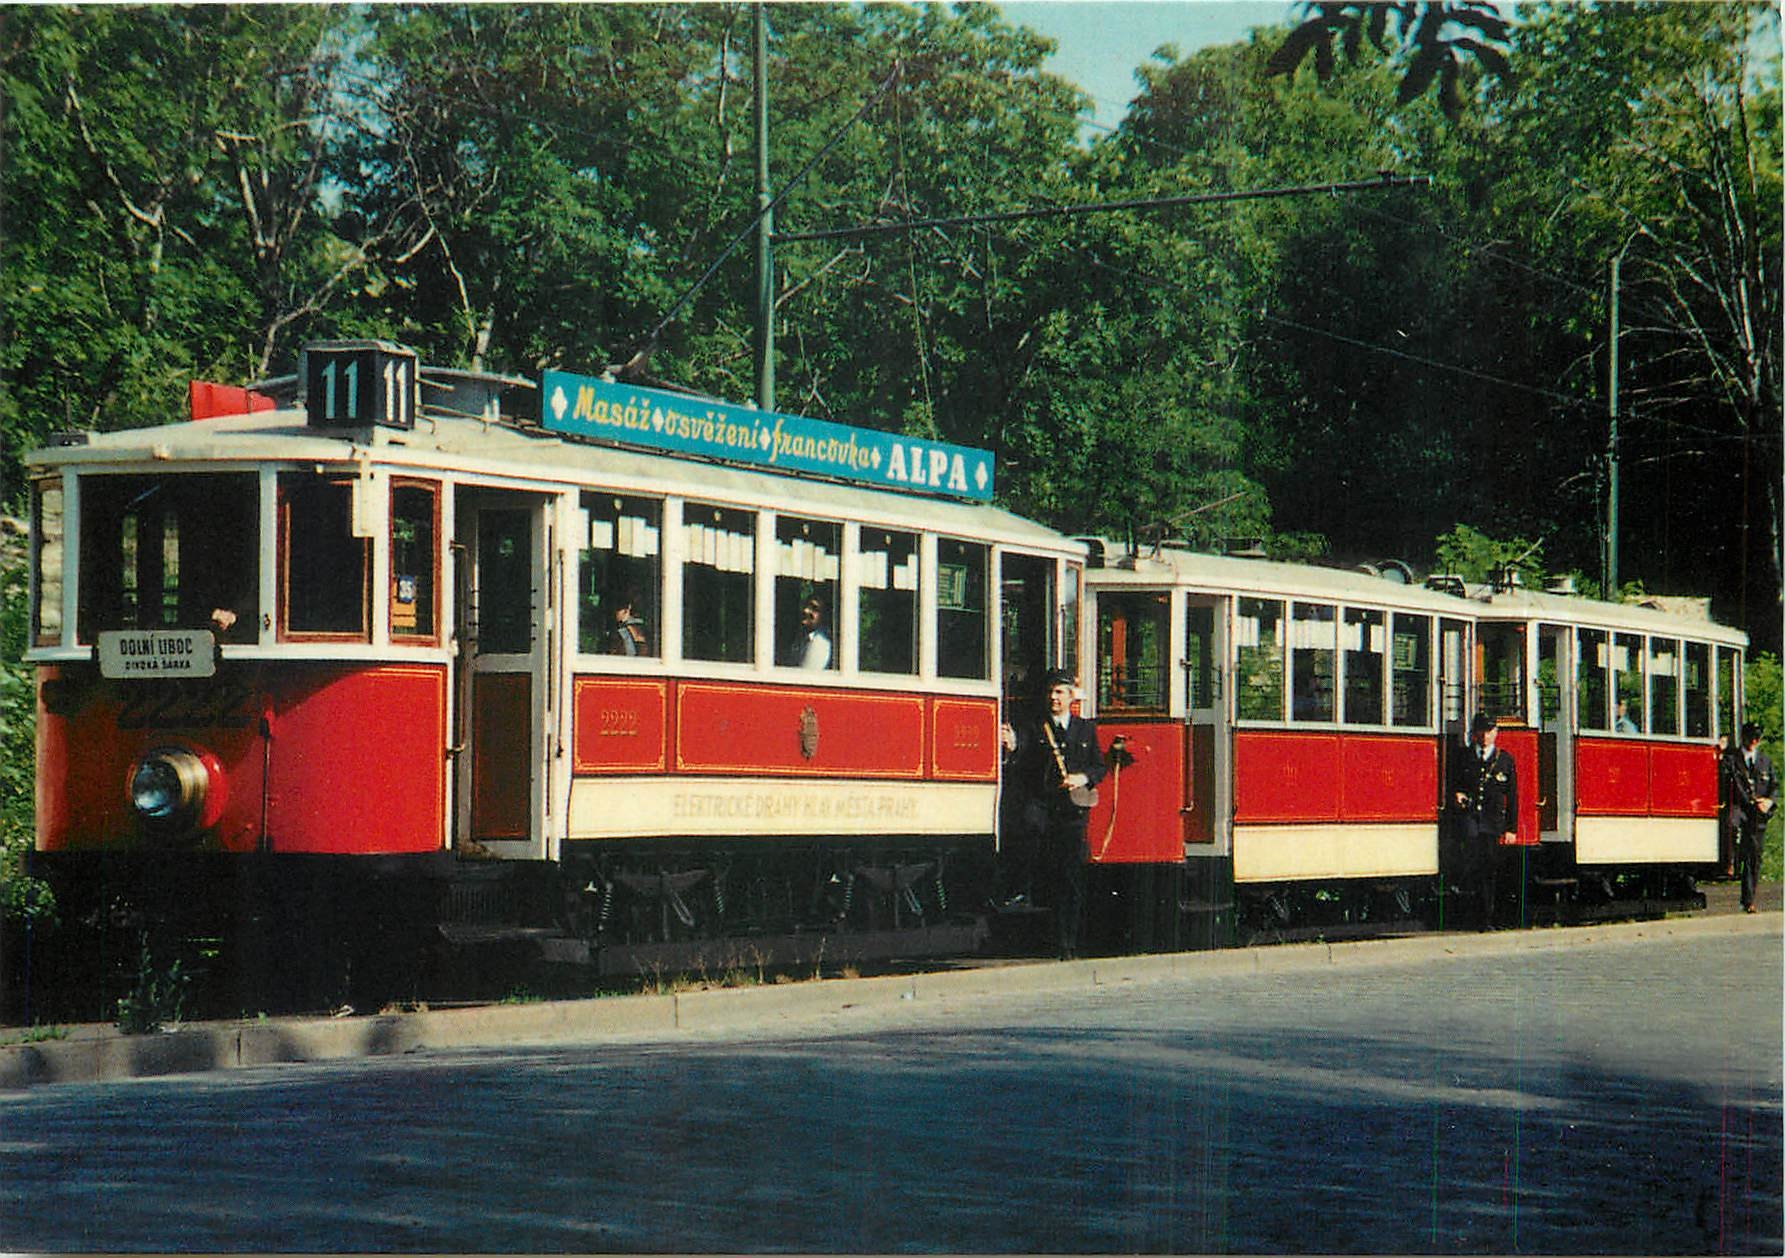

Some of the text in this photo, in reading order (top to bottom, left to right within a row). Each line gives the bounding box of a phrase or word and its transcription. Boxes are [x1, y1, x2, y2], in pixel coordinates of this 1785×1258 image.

[321, 360, 359, 419] 11
[383, 360, 408, 423] 11
[573, 384, 968, 491] Masáž osvěžení francovka ALPA
[119, 633, 194, 655] DOLNÍ LIBOC
